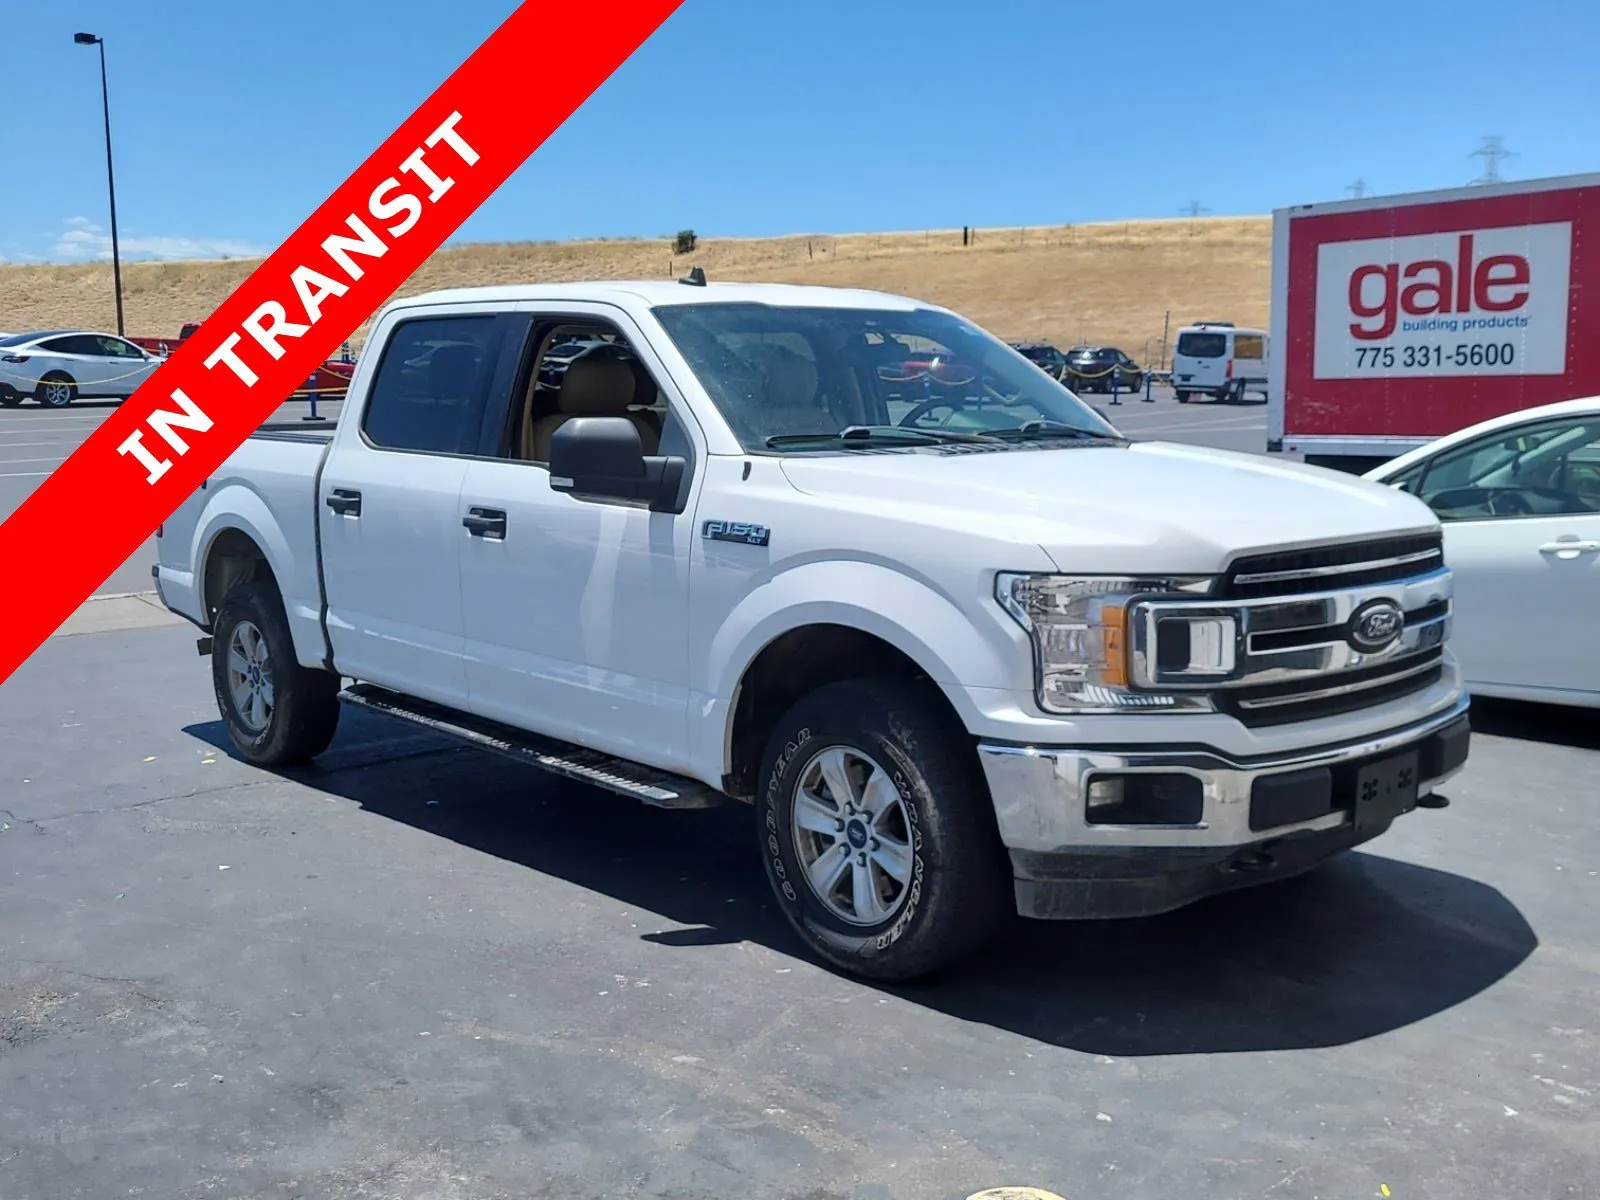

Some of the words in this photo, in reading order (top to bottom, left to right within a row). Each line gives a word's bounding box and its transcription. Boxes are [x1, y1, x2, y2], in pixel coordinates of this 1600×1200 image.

[1348, 234, 1530, 340] gale
[1355, 347, 1395, 368] 775
[1403, 343, 1514, 367] 331-5600
[1403, 318, 1458, 332] building
[1462, 315, 1528, 331] products
[1368, 614, 1397, 637] Ford
[766, 727, 812, 901] GOODYEAR
[876, 771, 925, 950] WRANGLER
